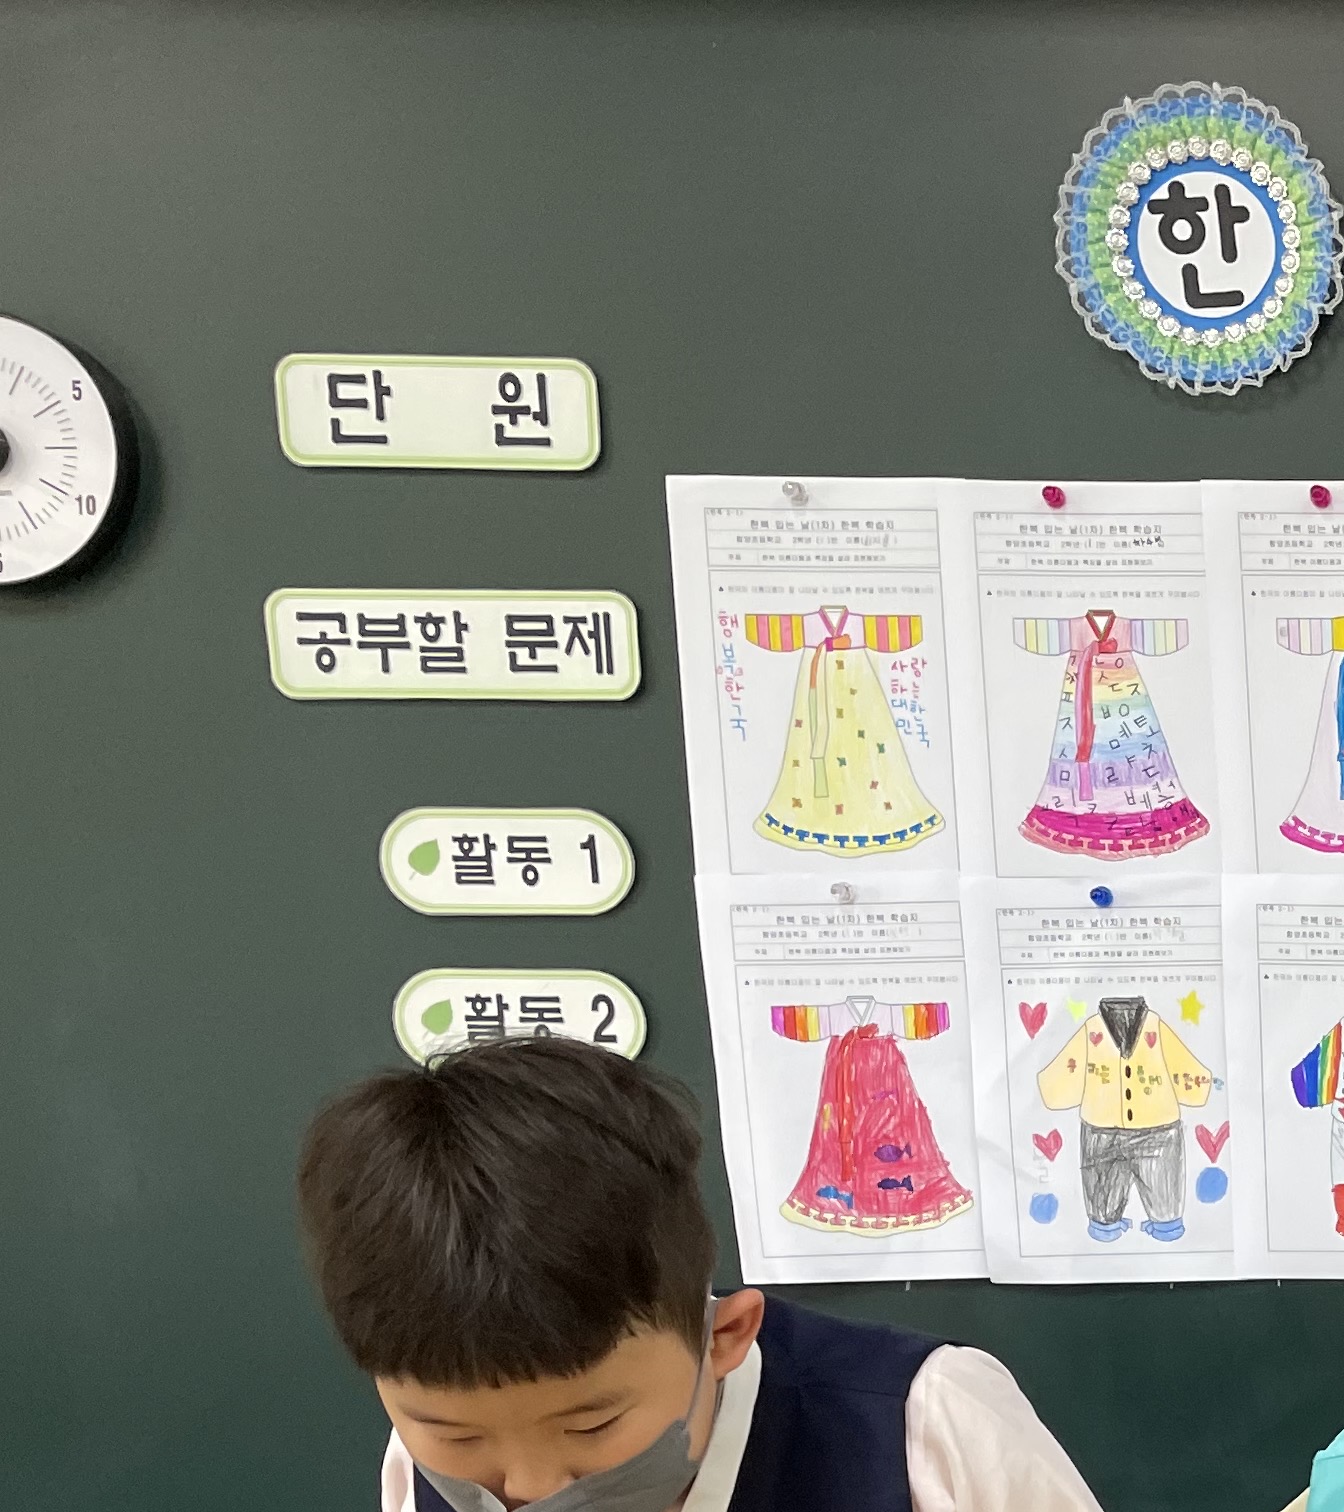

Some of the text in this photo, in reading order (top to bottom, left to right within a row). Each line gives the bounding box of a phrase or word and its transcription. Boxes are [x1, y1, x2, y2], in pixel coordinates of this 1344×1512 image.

[1147, 180, 1250, 309] 한
[71, 380, 82, 401] 5
[328, 371, 550, 446] 단 원
[75, 495, 96, 515] 10
[297, 611, 613, 674] 공부할 문제
[452, 834, 598, 885] 활동 1
[464, 993, 617, 1043] 활동 2
